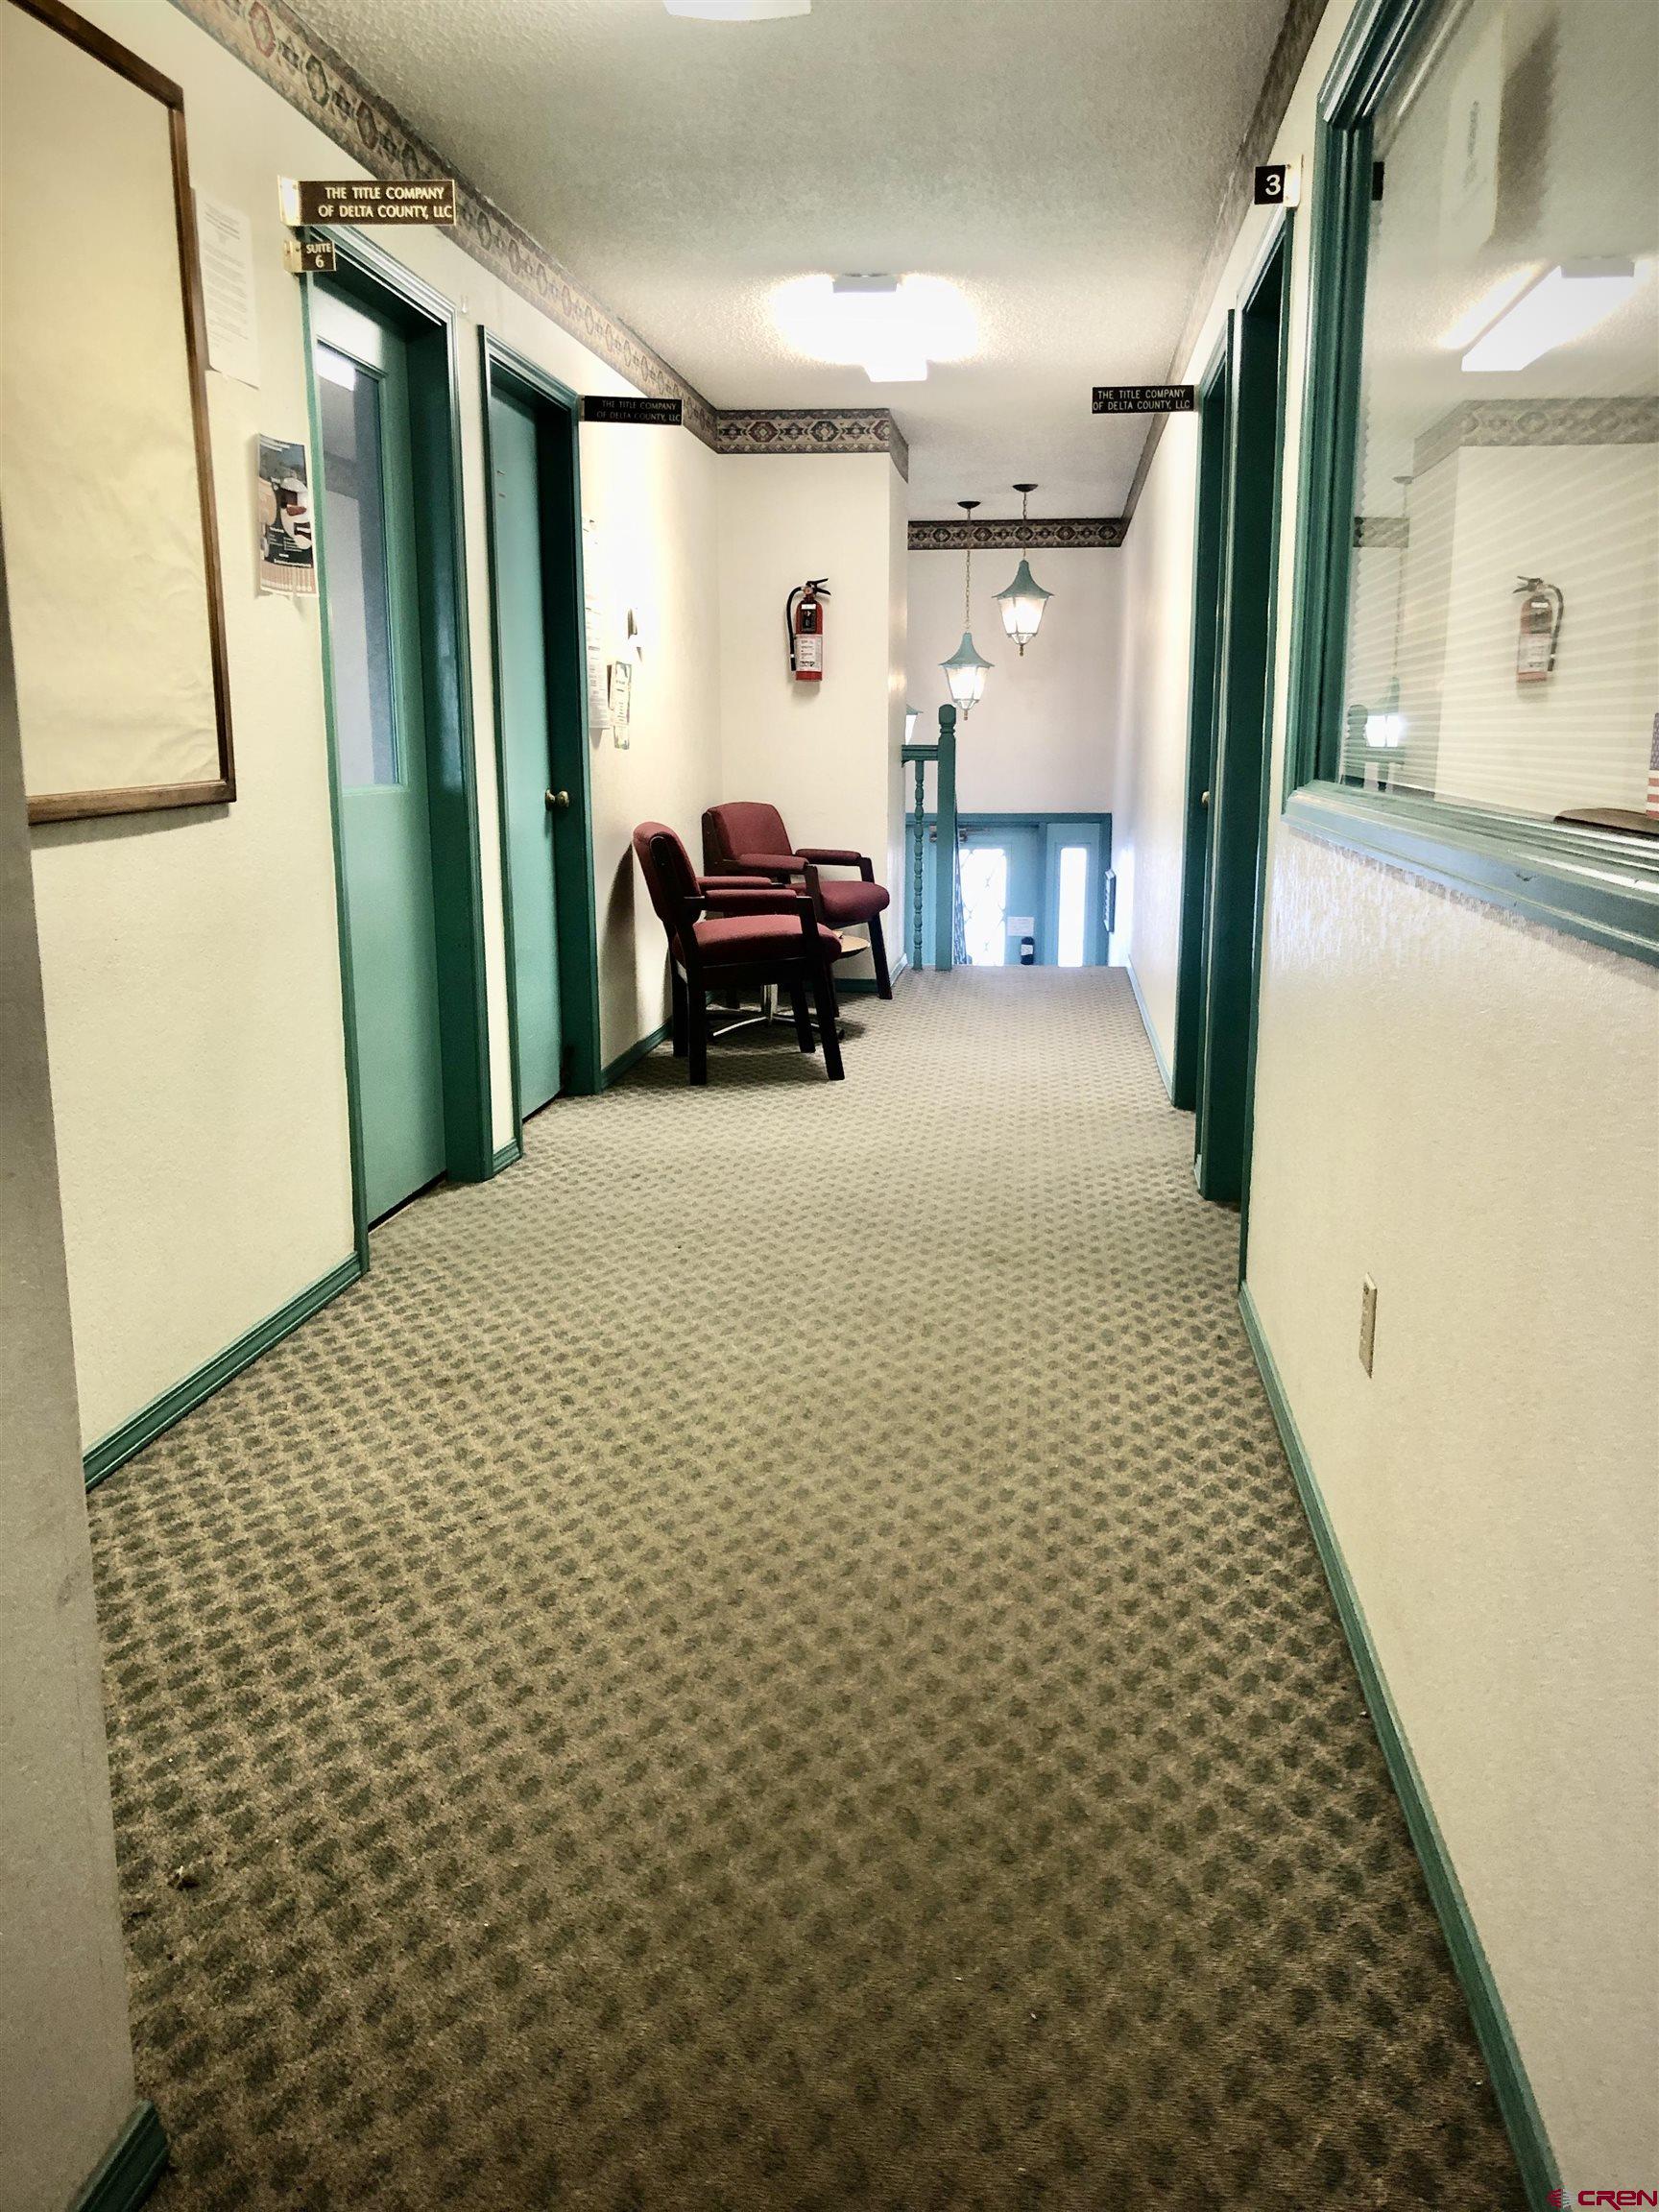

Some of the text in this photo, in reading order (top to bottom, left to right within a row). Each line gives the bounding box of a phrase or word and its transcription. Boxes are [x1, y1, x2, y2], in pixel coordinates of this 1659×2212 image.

[1265, 174, 1281, 196] 3
[325, 187, 445, 200] THE TITLE COMPANY
[318, 205, 452, 220] OF DELTA COUNTY, LLC
[306, 243, 332, 253] SUITE
[315, 254, 325, 269] 6
[1097, 389, 1186, 399] THE TITLE COMPANY
[639, 401, 676, 410] COMPANY
[1093, 401, 1102, 411] OF
[1108, 401, 1133, 411] DELTA
[1175, 399, 1190, 409] LLC
[668, 414, 681, 422] LLC
